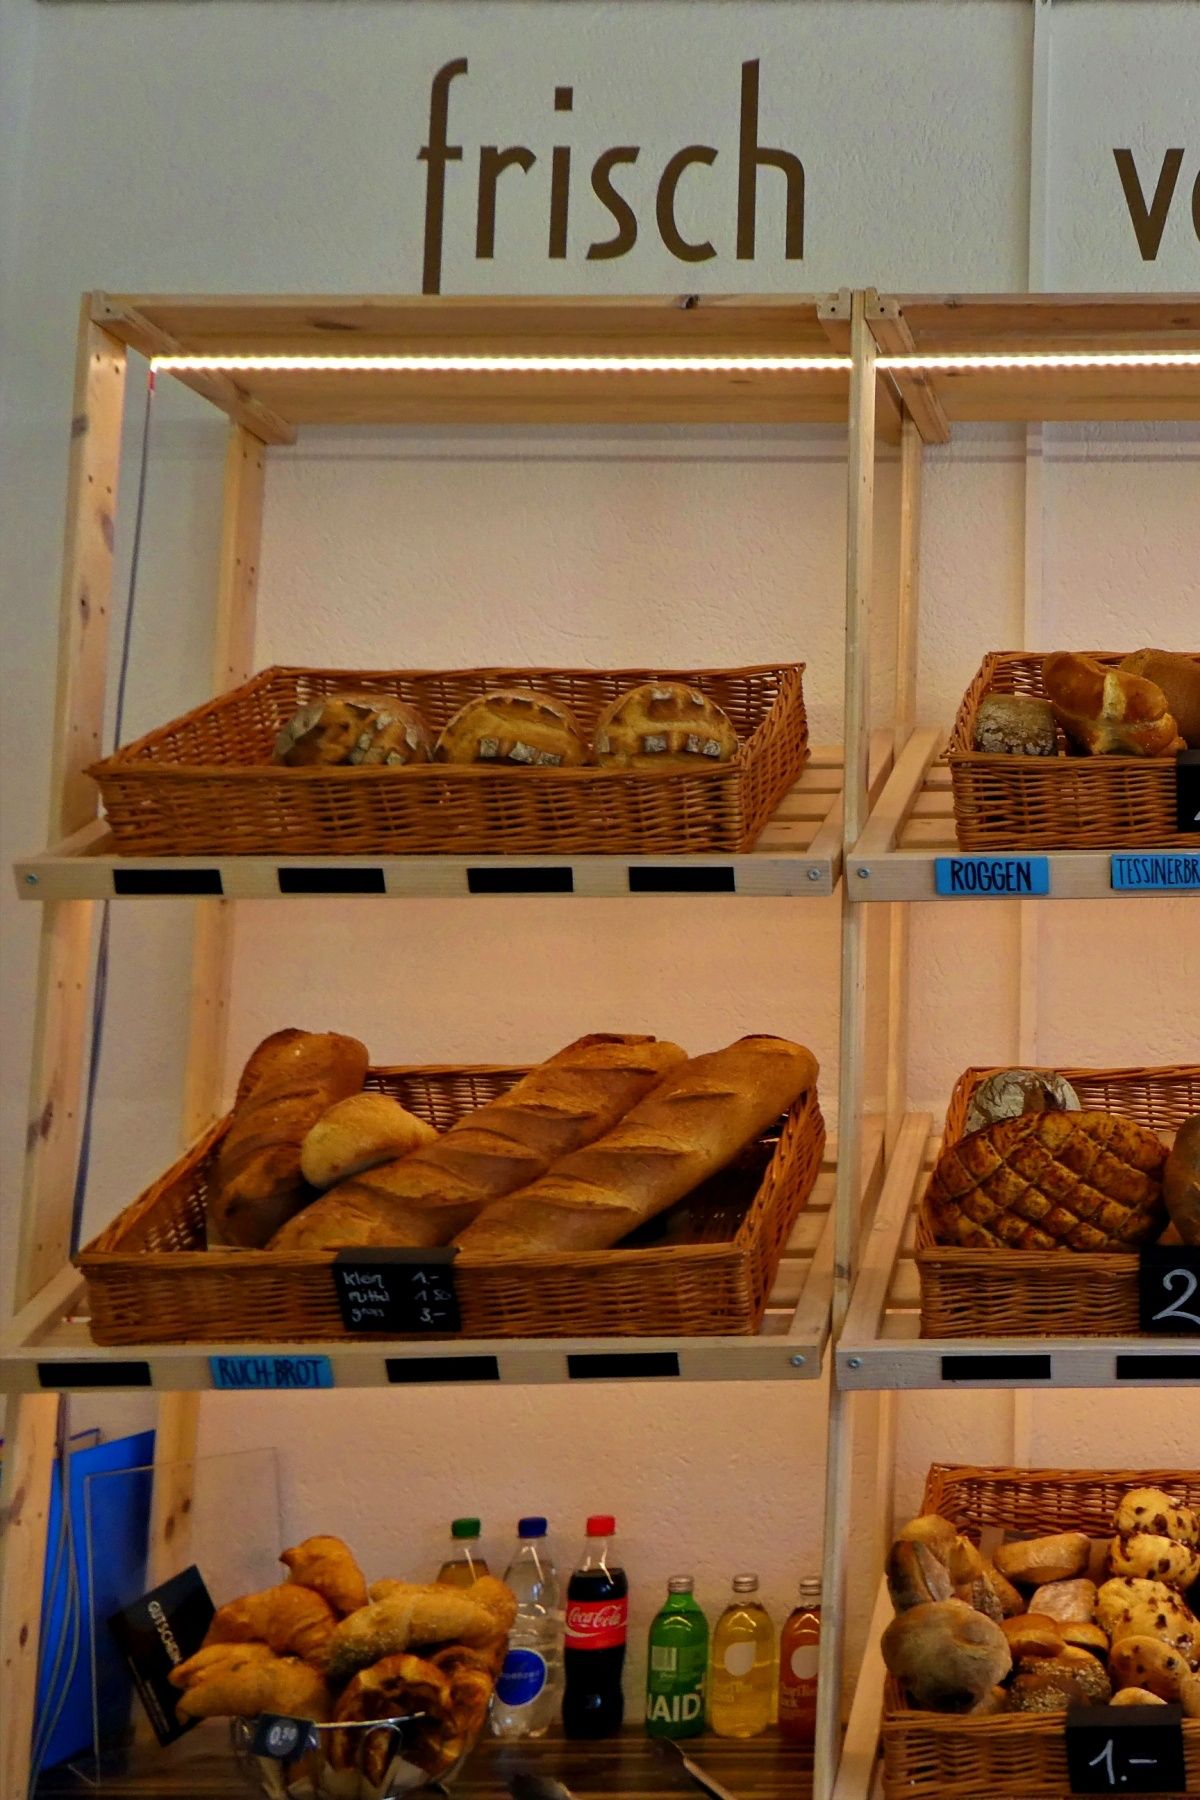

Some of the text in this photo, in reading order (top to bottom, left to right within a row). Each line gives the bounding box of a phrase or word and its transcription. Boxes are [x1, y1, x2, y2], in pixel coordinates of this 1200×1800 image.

[417, 57, 805, 295] frisch
[949, 859, 1032, 892] ROGGEN
[648, 1692, 702, 1723] AID
[1088, 1738, 1158, 1785] 1.-
